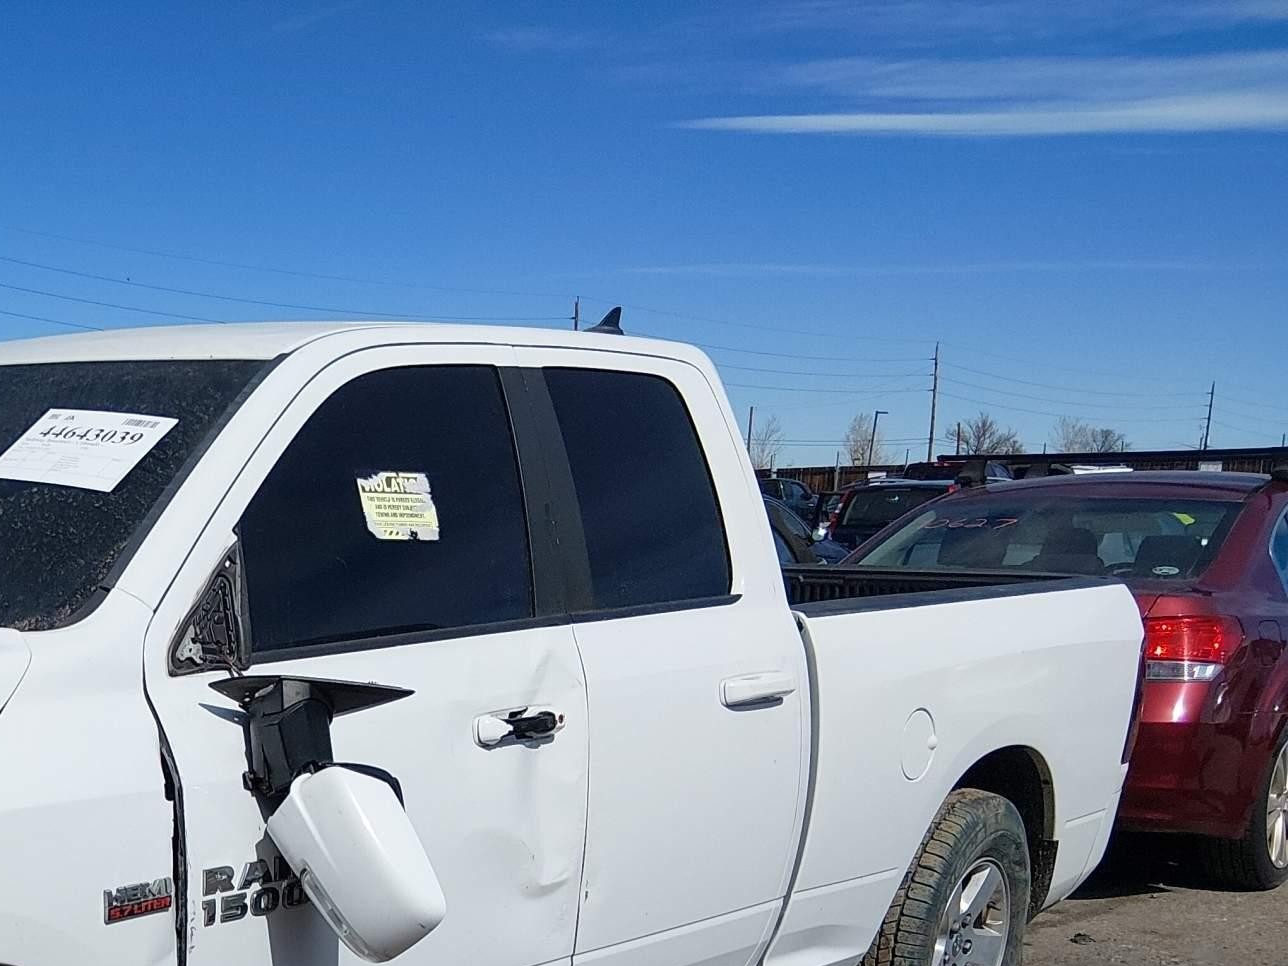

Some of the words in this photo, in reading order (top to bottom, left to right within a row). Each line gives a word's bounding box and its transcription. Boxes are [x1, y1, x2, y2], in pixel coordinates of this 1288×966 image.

[40, 425, 144, 446] 44643039
[103, 877, 172, 906] HEMI
[201, 881, 309, 928] 1500
[110, 904, 133, 920] 5.7
[133, 896, 171, 914] LITER
